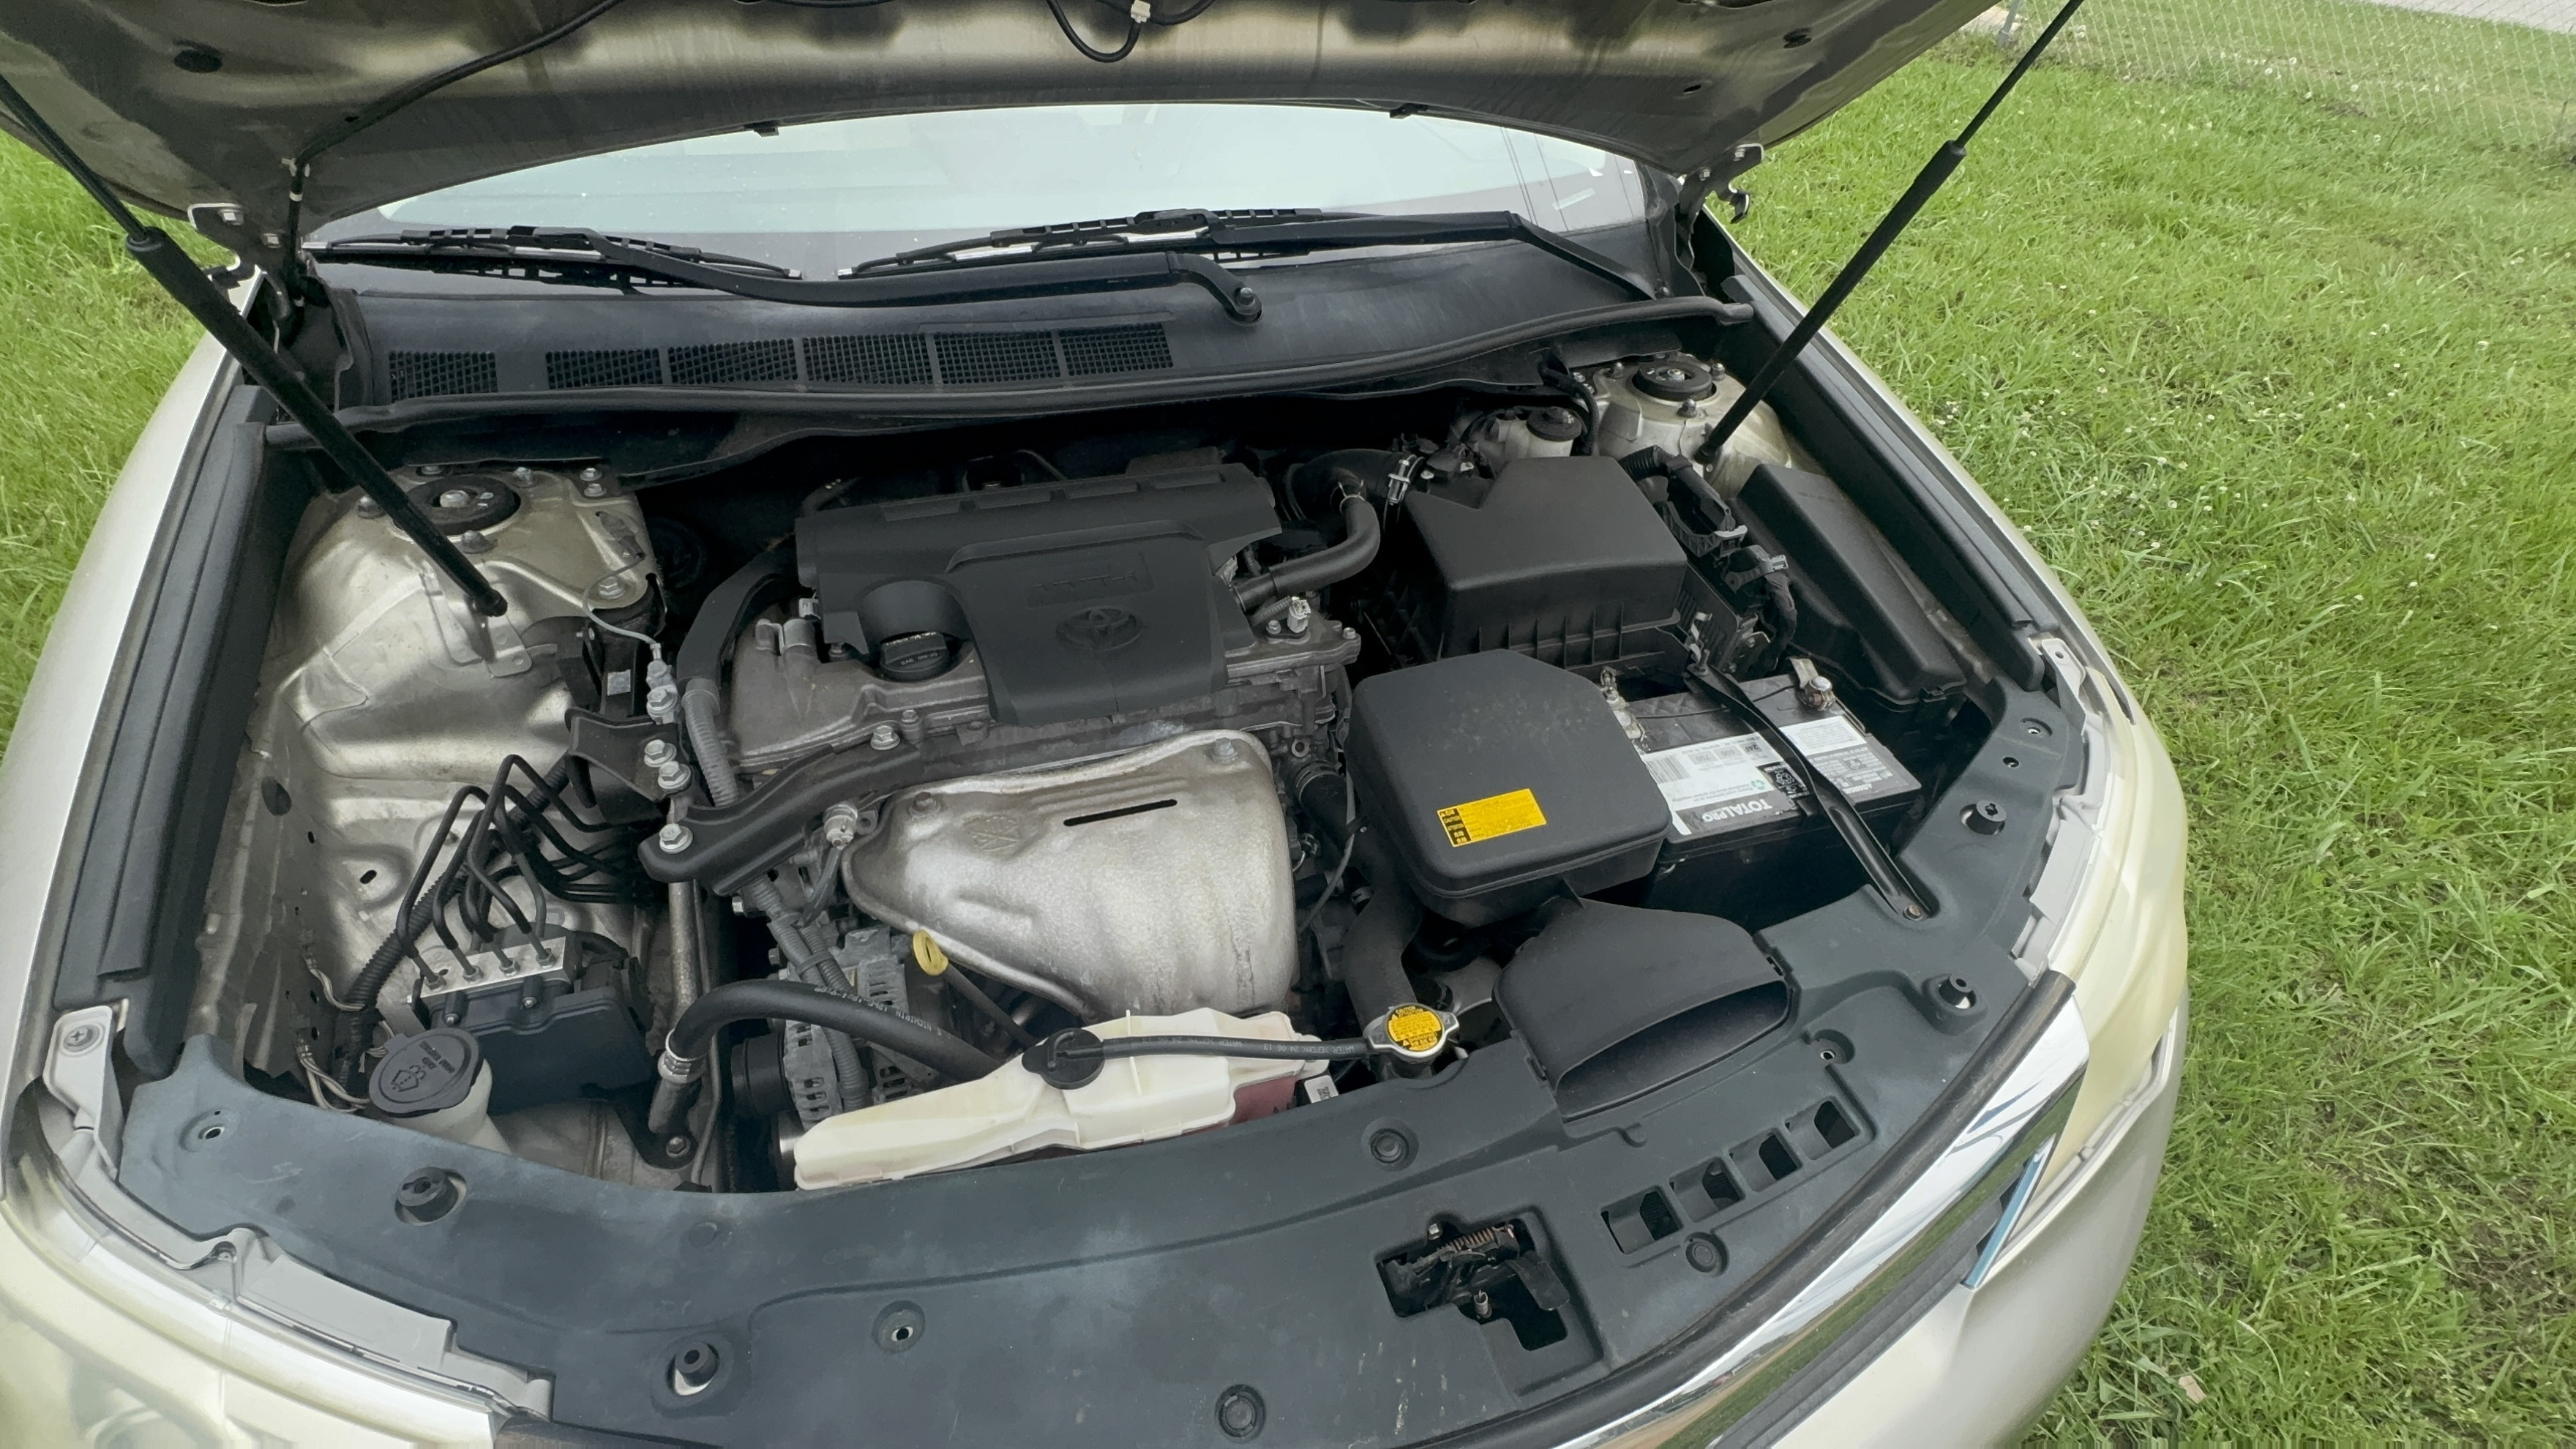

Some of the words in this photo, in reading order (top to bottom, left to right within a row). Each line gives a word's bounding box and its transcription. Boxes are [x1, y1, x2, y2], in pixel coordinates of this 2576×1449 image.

[1745, 744, 1759, 752] 24F
[1701, 798, 1773, 823] TOTALPRO
[895, 1010, 932, 1032] NICHIRIN
[1277, 1044, 1287, 1052] 06
[1289, 1045, 1299, 1053] 24
[1333, 1045, 1355, 1054] WATER
